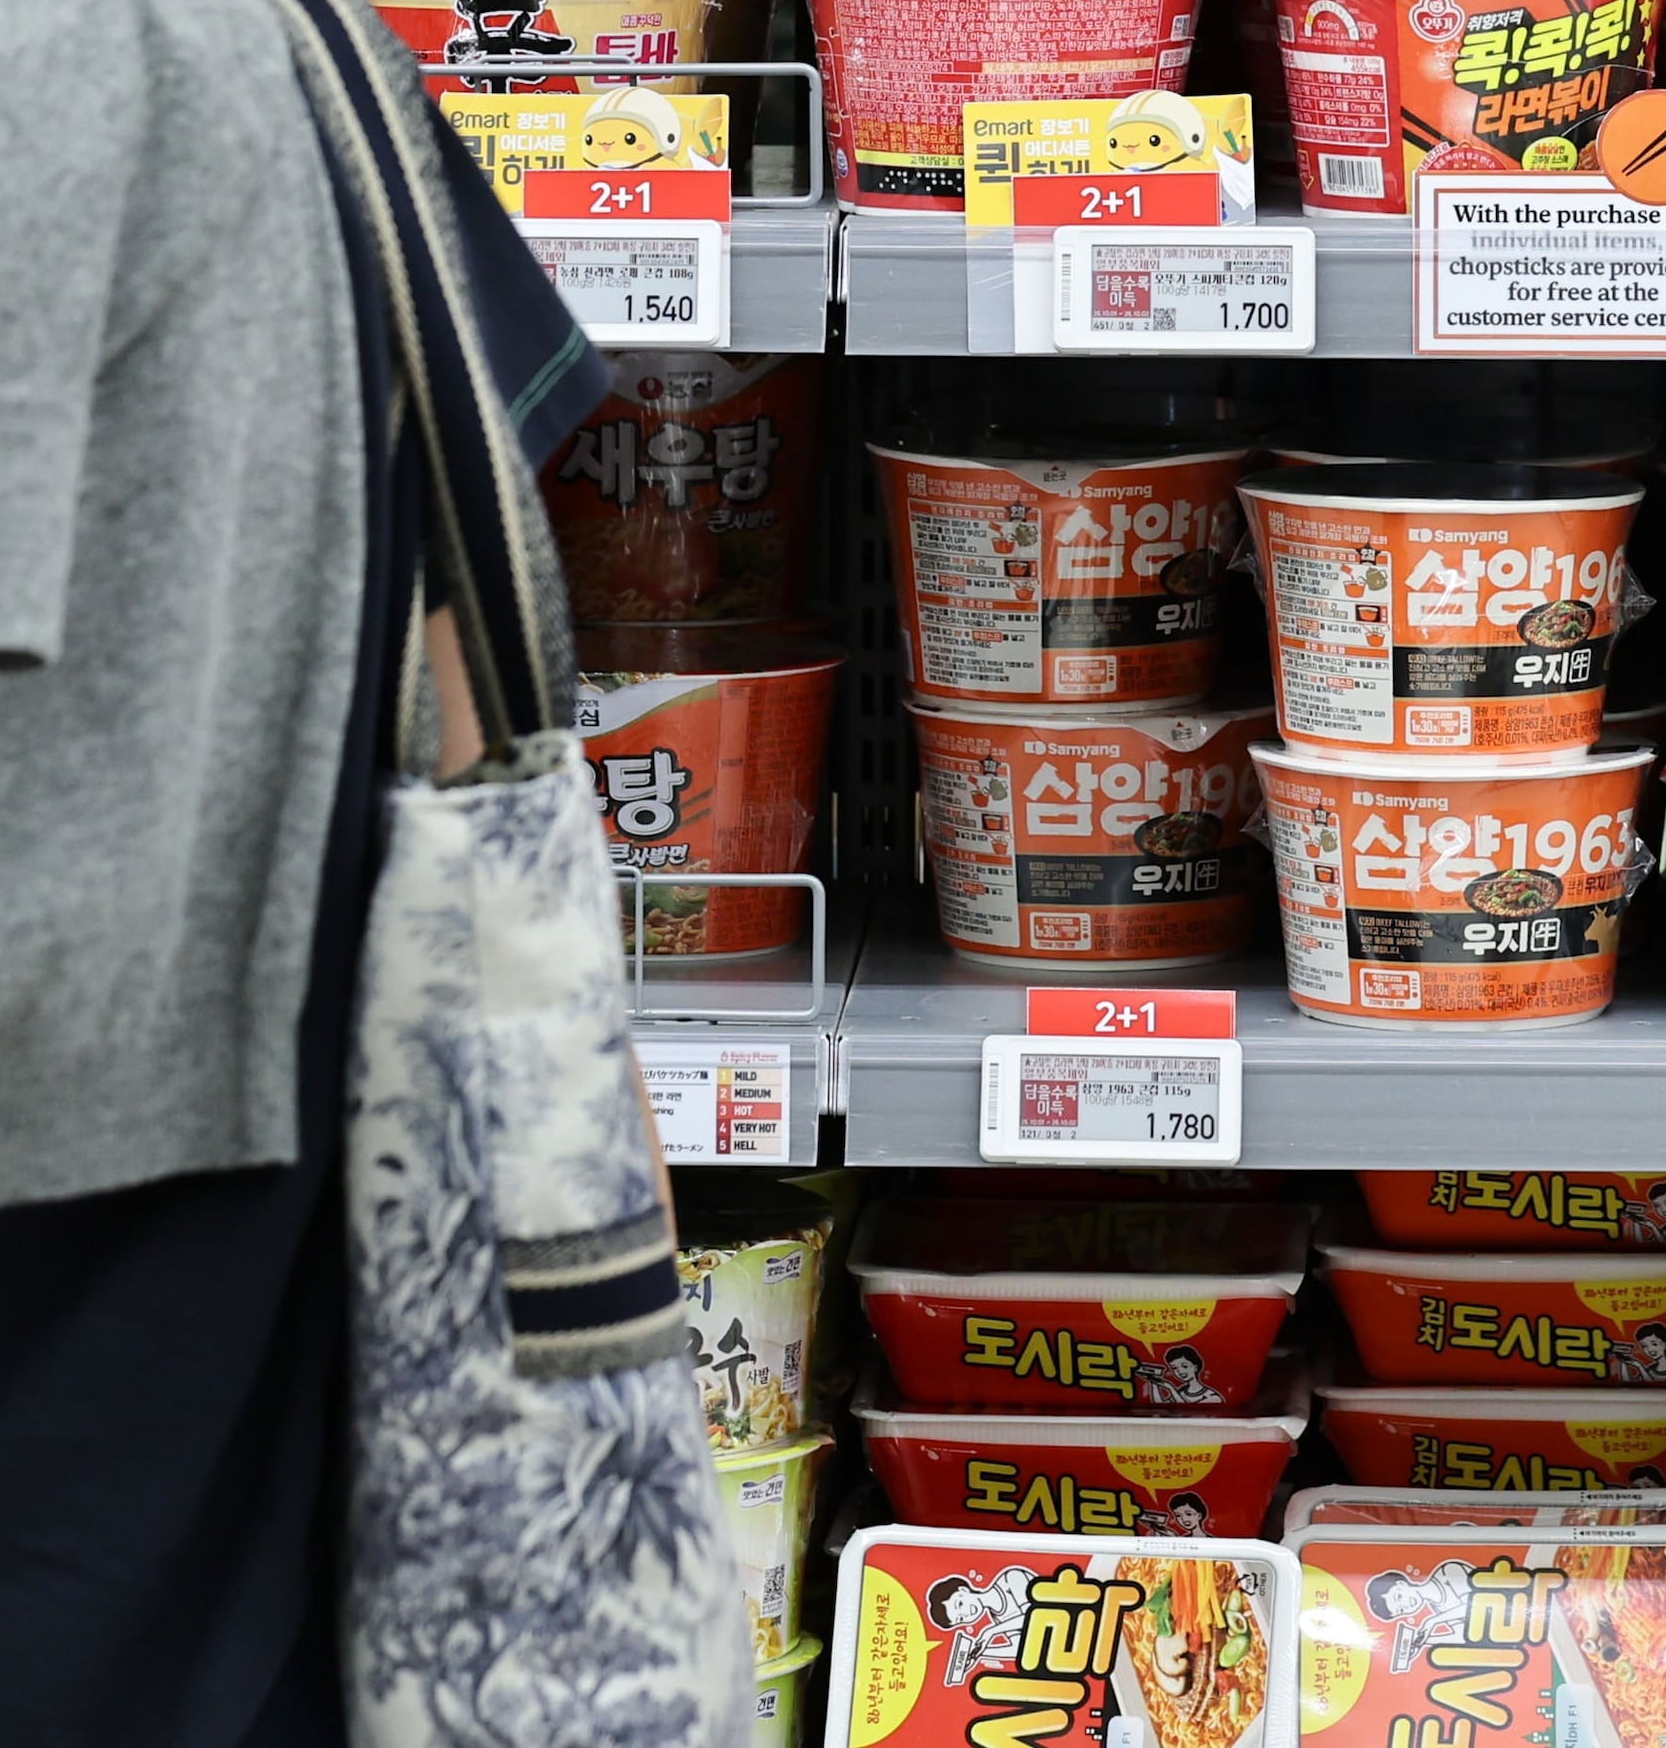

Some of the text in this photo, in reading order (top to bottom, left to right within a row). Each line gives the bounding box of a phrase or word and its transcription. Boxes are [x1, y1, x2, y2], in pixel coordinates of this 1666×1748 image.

[1475, 72, 1611, 136] 라면볶이
[589, 180, 654, 215] 2+1
[1081, 187, 1143, 219] 2+1
[1454, 204, 1508, 224] With
[1515, 205, 1551, 223] the
[1557, 205, 1660, 228] purchase
[1471, 231, 1663, 254] individual items,
[1449, 257, 1566, 280] chopsticks
[1571, 262, 1605, 275] are
[1508, 282, 1658, 301] for free at the
[623, 293, 695, 324] 1,540
[1220, 302, 1290, 331] 1,700
[1447, 310, 1545, 326] customer
[1551, 309, 1629, 326] service
[559, 420, 781, 507] 새우탕
[1434, 529, 1508, 546] Samyang
[1375, 793, 1449, 811] Samyang
[1094, 999, 1158, 1032] 2+1
[735, 1090, 771, 1098] MEDIUM
[735, 1124, 776, 1133] VERY HOT
[1145, 1112, 1216, 1141] 1,780
[734, 1141, 756, 1150] HELL
[1417, 1297, 1614, 1382] 김치 도시락
[964, 1315, 1141, 1399] 도시락
